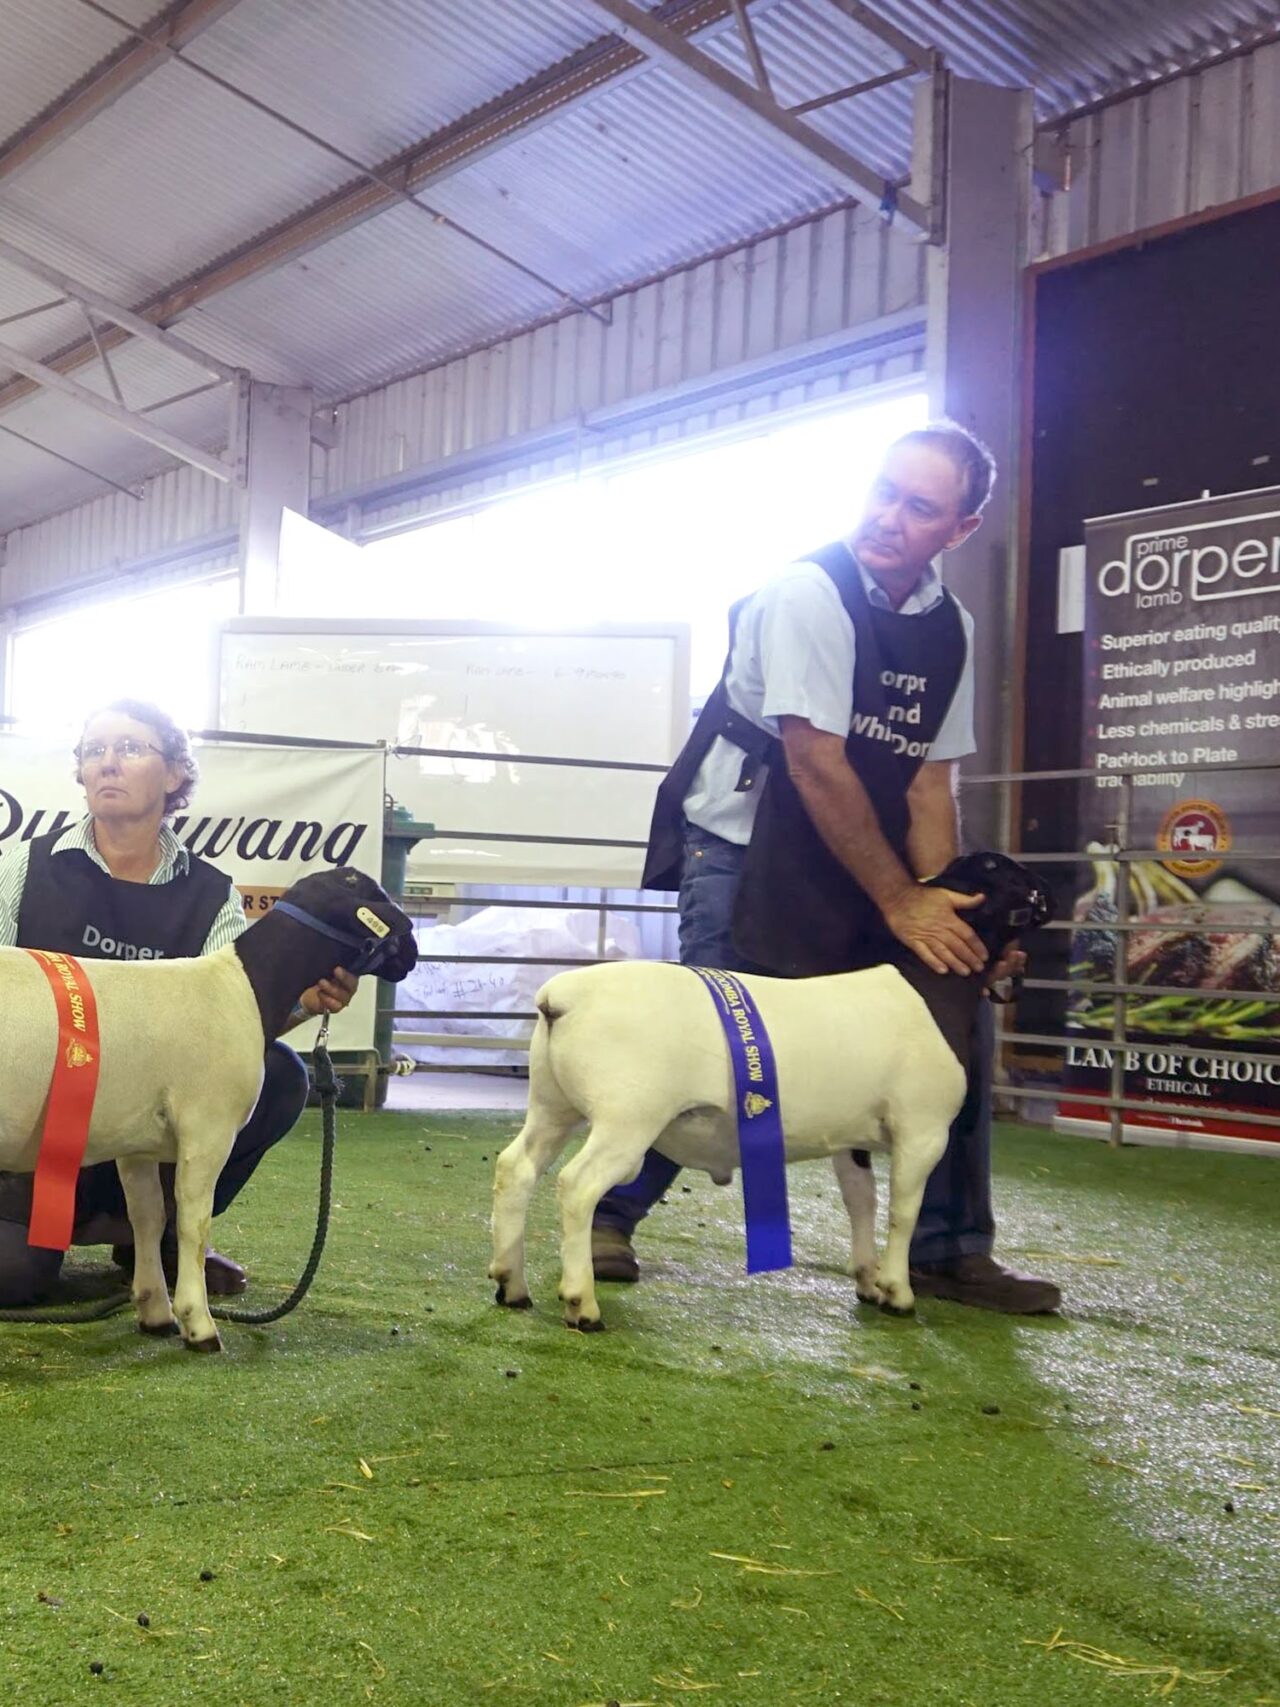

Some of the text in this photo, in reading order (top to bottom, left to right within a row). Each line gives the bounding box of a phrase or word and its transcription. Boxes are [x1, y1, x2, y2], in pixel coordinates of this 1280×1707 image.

[1136, 535, 1189, 558] prime
[1136, 588, 1183, 608] lamb
[1101, 630, 1170, 651] Superior
[1173, 624, 1227, 641] eating
[1103, 649, 1256, 680] Ethically produced
[1099, 691, 1152, 709] Animal
[1156, 686, 1215, 705] welfare
[1098, 725, 1135, 739] Less
[1140, 716, 1224, 737] chemicals
[1229, 714, 1241, 730] &
[1171, 750, 1189, 765] to
[1193, 747, 1238, 764] Plate
[82, 924, 165, 961] Dorper
[69, 991, 87, 1032] SHOW
[732, 1008, 756, 1044] ROYAL
[745, 1045, 764, 1082] SHOW
[1145, 1053, 1183, 1075] OF
[1146, 1078, 1211, 1097] ETHICAL
